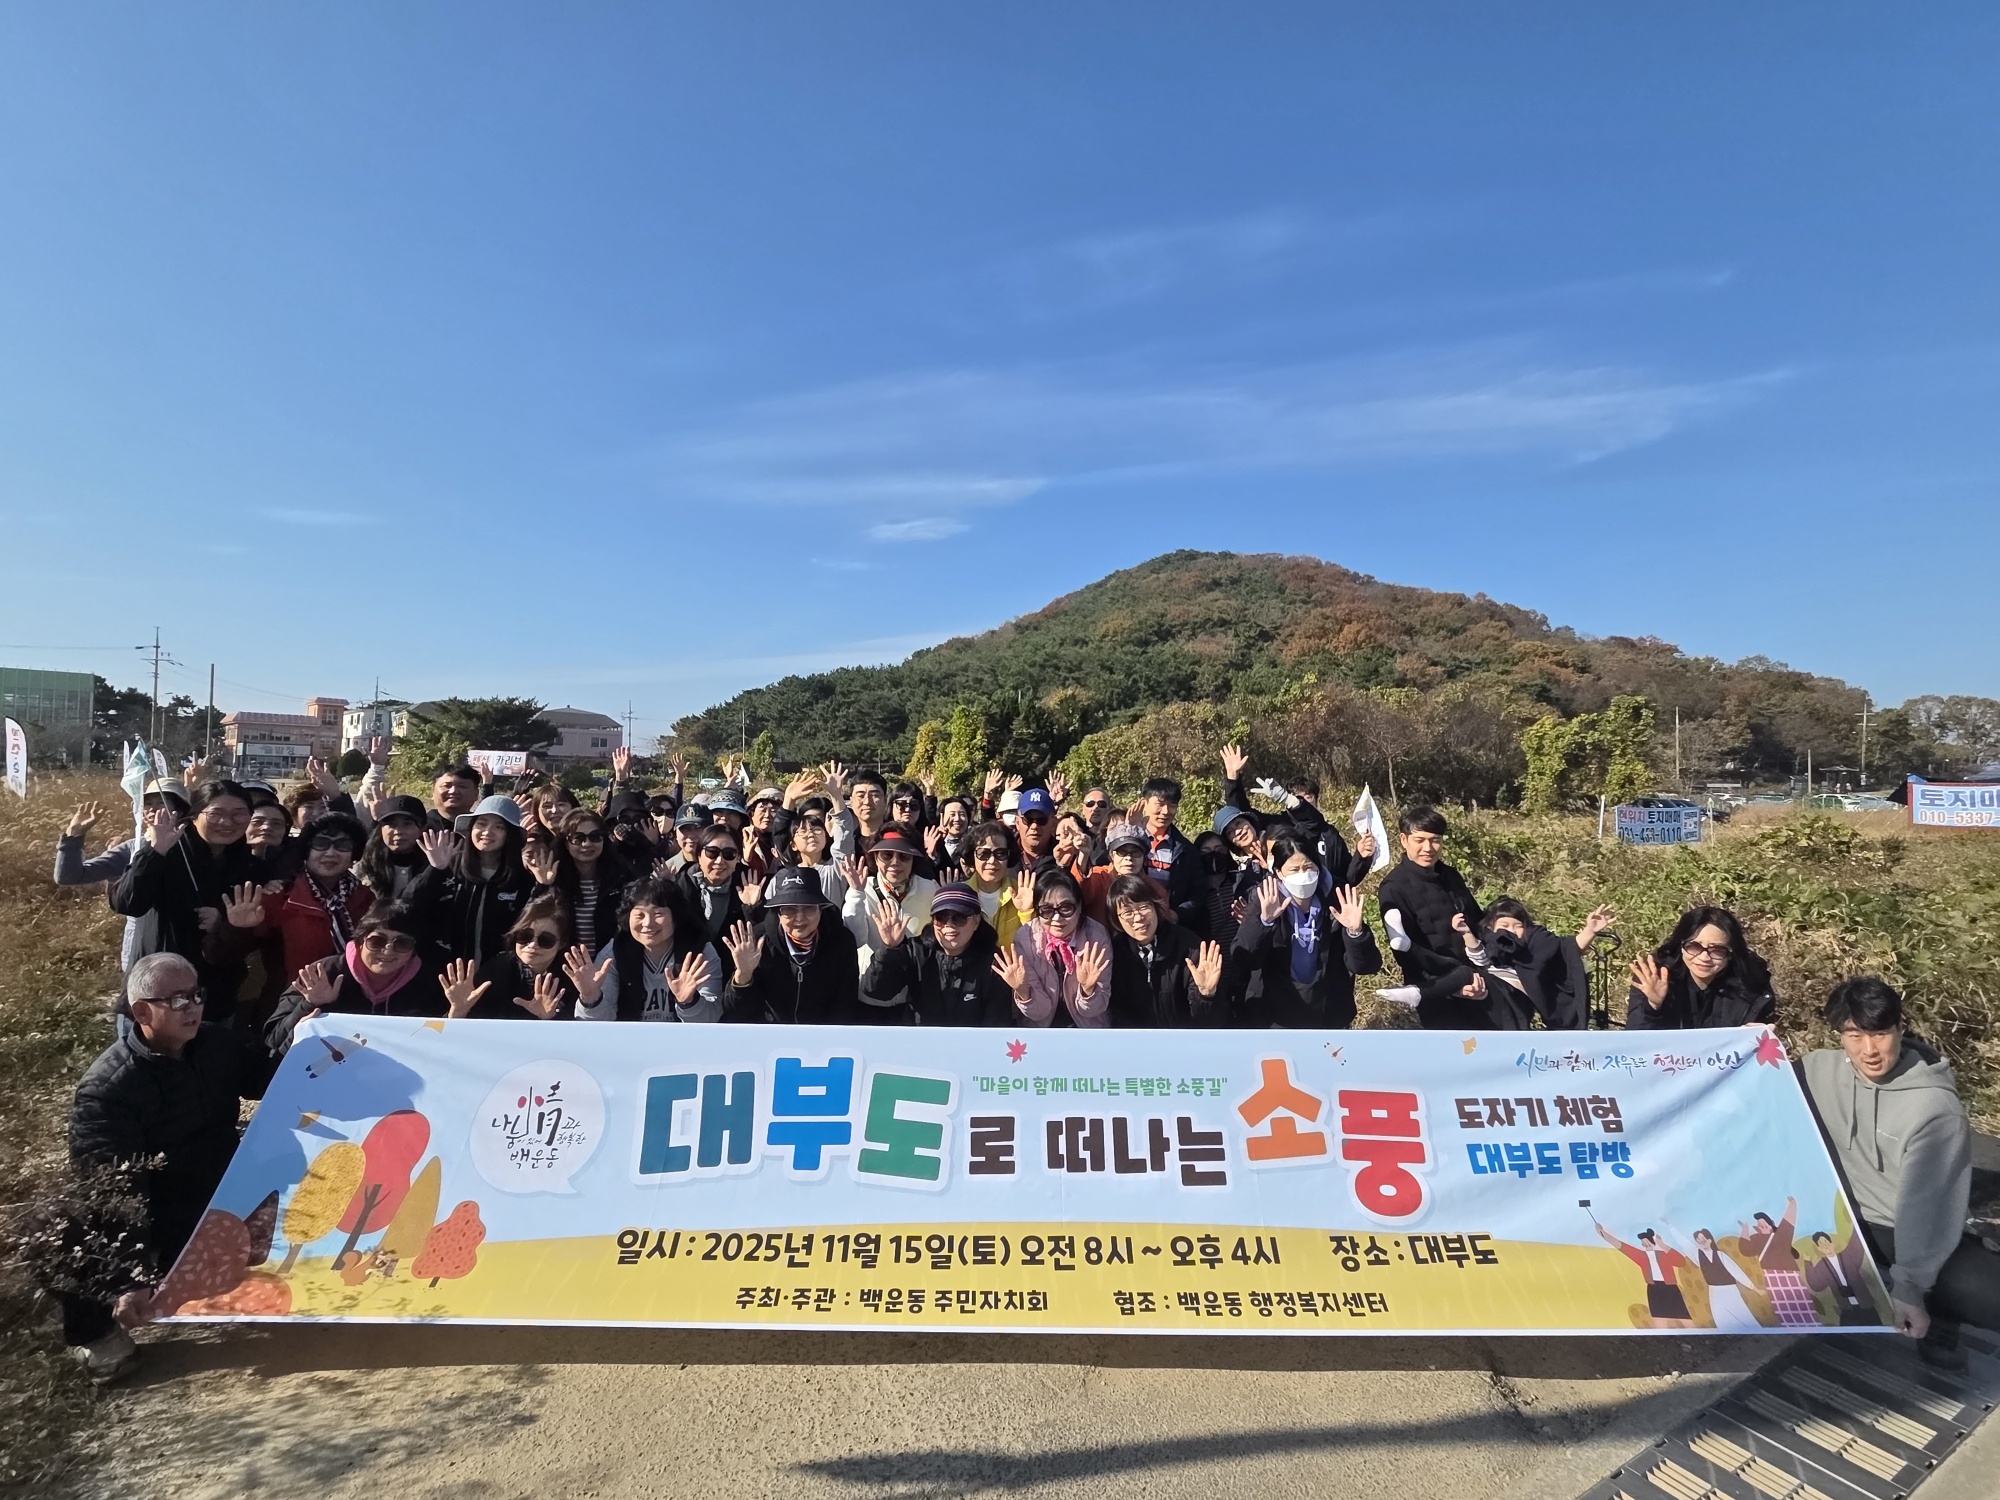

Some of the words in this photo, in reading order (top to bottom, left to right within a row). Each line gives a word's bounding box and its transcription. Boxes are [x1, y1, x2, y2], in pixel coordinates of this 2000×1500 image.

[496, 755, 522, 766] 카리브
[1647, 810, 1681, 824] 토지매매
[1653, 1054, 1702, 1076] 혁신도시
[1707, 1051, 1747, 1070] 안산
[1033, 1076, 1068, 1096] 함께
[1072, 1077, 1121, 1097] 떠나는
[1125, 1077, 1172, 1097] 특별한
[1454, 1097, 1550, 1129] 도자기
[1553, 1095, 1624, 1133] 체험
[1046, 1116, 1227, 1187] 떠나는
[1238, 1058, 1426, 1217] 소풍
[510, 1148, 560, 1170] 백운동
[1466, 1142, 1562, 1178] 대부도
[1568, 1141, 1635, 1180] 탐방
[702, 1232, 815, 1268] 2025년
[822, 1232, 882, 1269] 11월
[889, 1234, 1011, 1270] 15일(토)
[1020, 1235, 1076, 1271] 오전
[1231, 1236, 1281, 1266] 4시
[1408, 1234, 1499, 1269] 대부도
[735, 1286, 837, 1312] 주최·주관
[859, 1288, 926, 1314] 백운동
[934, 1290, 1049, 1314] 주민자치회
[1113, 1290, 1157, 1317] 협조
[1176, 1291, 1243, 1318] 백운동
[1248, 1291, 1389, 1318] 행정복지센터
